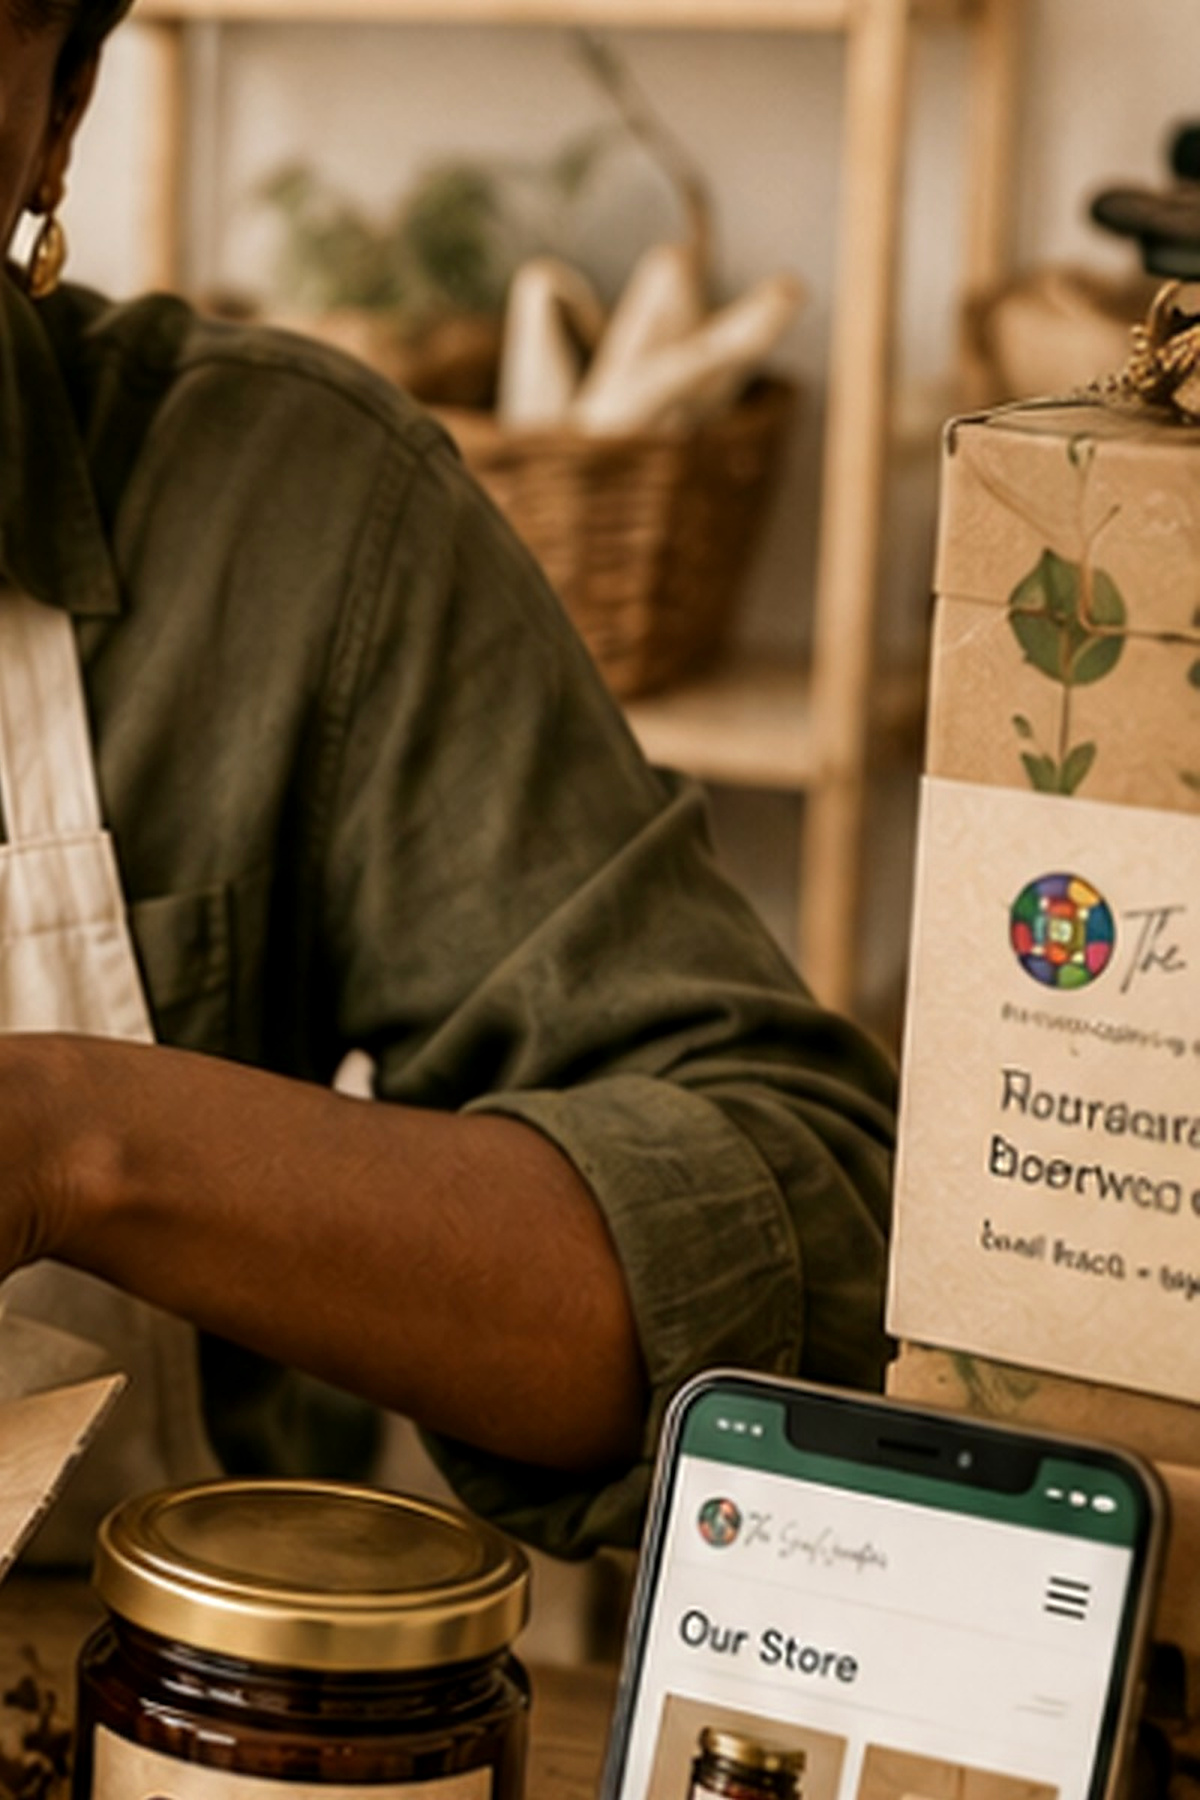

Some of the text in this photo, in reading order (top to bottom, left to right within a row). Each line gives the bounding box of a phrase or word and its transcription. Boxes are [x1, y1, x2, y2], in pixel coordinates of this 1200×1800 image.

[1120, 905, 1187, 994] The
[679, 1609, 860, 1684] Our Store
